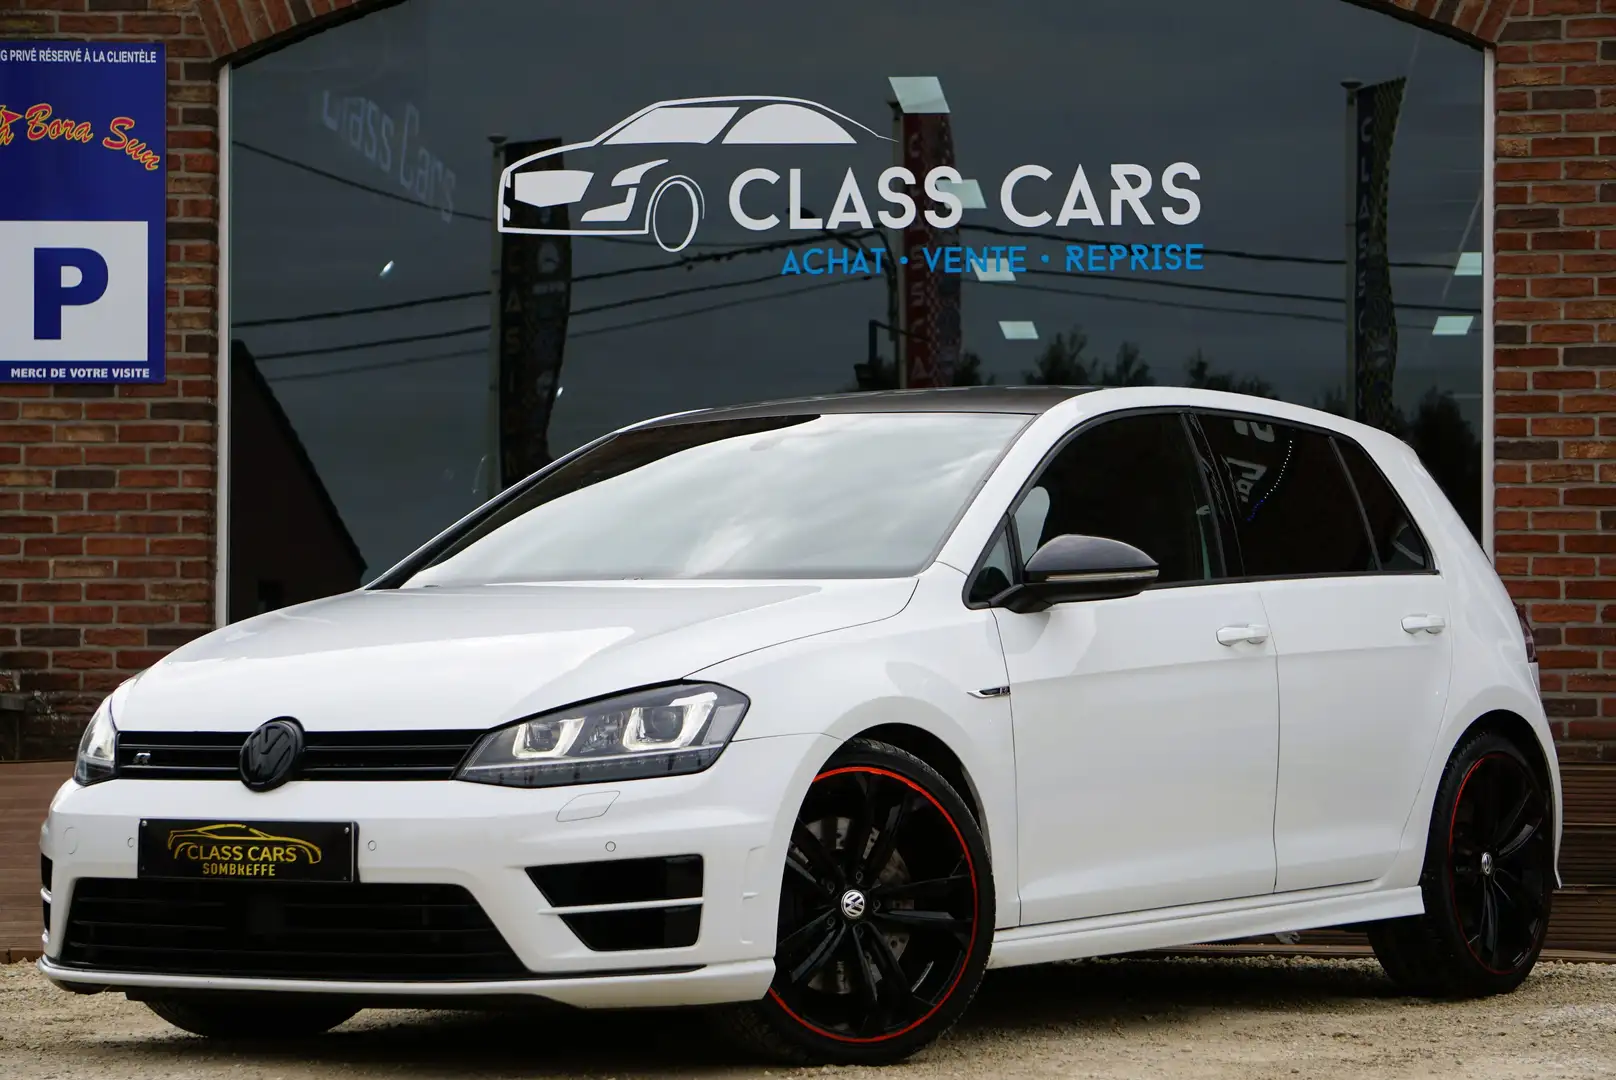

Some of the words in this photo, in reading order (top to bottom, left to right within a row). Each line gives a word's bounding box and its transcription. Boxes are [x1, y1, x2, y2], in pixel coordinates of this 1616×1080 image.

[10, 47, 37, 62] PRIVÉ
[39, 47, 82, 62] RÉSERVÉ
[84, 47, 91, 63] À
[93, 50, 106, 63] LA
[107, 49, 157, 63] CLIENTÈLE
[25, 103, 93, 143] Bora
[102, 117, 160, 170] Sun
[728, 165, 963, 230] CLASS
[1000, 162, 1202, 227] CARS
[781, 247, 887, 275] ACHAT
[922, 245, 1028, 273] VENTE
[1065, 243, 1205, 272] REPRISE
[34, 247, 109, 340] P
[10, 368, 47, 379] MERCI
[50, 368, 66, 379] DE
[69, 368, 108, 379] VOTRE
[111, 368, 150, 379] VISITE
[186, 845, 243, 861] CLASS
[247, 846, 297, 863] CARS
[202, 862, 276, 877] SOMBREFFE
